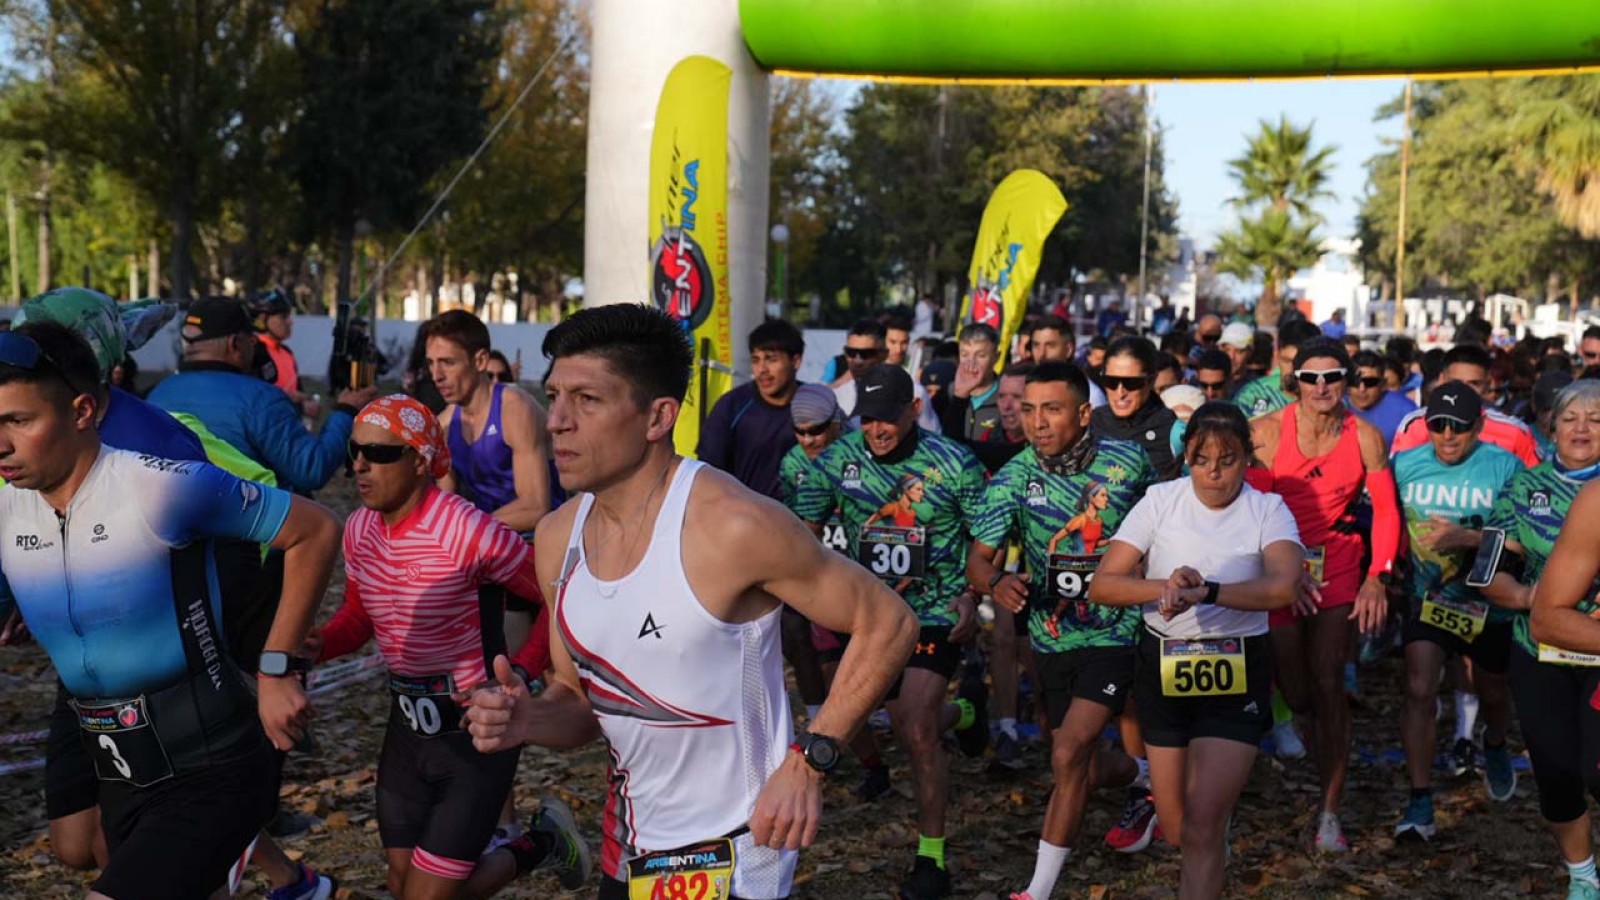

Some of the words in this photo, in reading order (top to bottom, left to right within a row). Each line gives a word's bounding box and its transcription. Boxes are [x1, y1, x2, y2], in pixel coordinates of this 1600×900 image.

[675, 158, 699, 325] ENTINA
[715, 210, 727, 266] CHIP
[716, 277, 731, 364] SISTEMA
[1404, 480, 1493, 509] JUNÍN
[16, 535, 38, 547] RTO
[871, 543, 910, 575] 30
[1056, 571, 1094, 598] 9
[1430, 606, 1474, 637] 553
[1174, 659, 1233, 692] 560
[398, 694, 441, 734] 90
[98, 734, 131, 779] 3
[645, 852, 717, 870] ARGENTINA
[650, 871, 709, 900] 482
